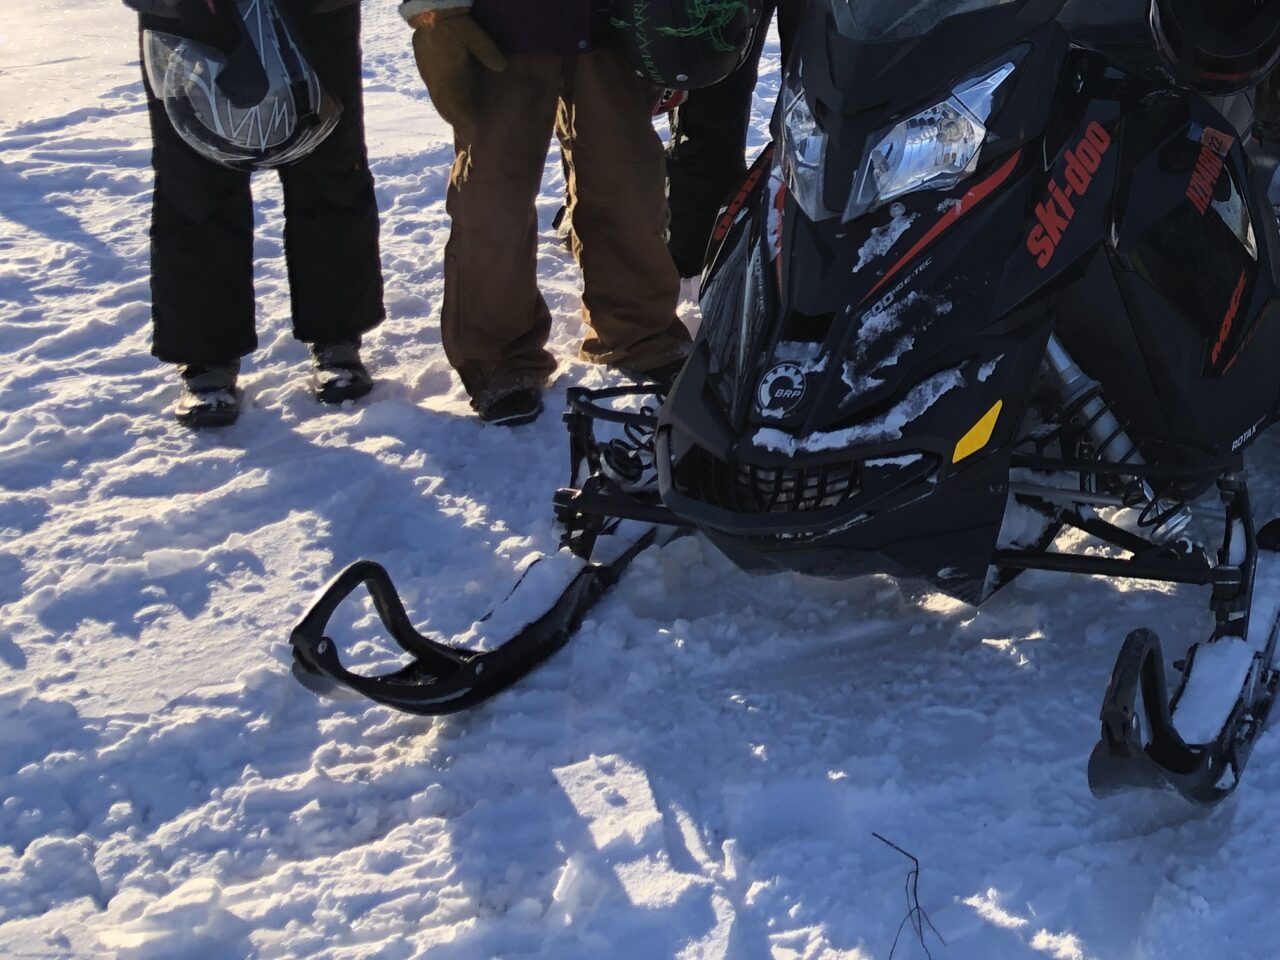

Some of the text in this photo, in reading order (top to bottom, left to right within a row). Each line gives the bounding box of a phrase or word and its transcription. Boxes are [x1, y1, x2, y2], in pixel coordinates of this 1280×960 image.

[1208, 136, 1223, 151] 22
[1026, 120, 1112, 269] ski-doo
[774, 388, 802, 399] BRP
[1231, 425, 1257, 453] ROTAX
